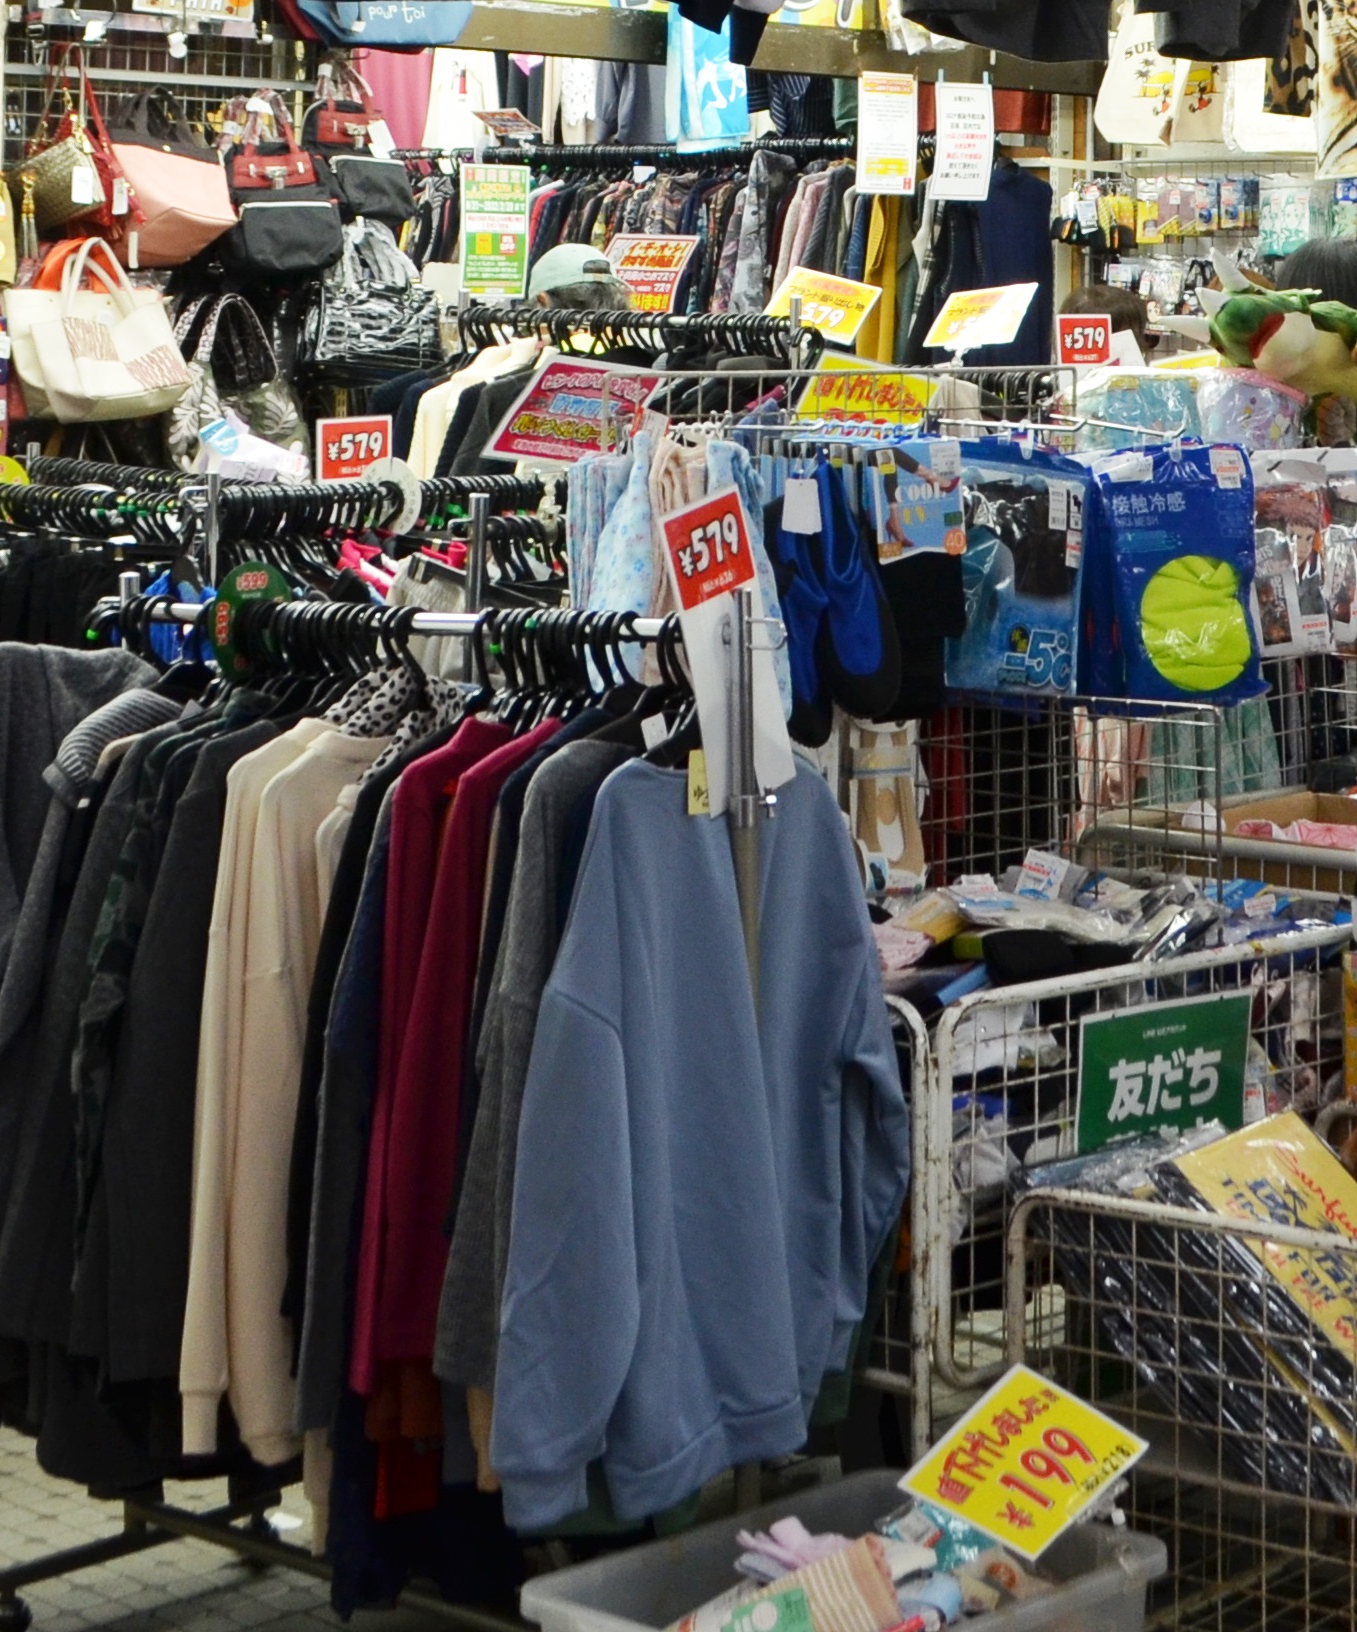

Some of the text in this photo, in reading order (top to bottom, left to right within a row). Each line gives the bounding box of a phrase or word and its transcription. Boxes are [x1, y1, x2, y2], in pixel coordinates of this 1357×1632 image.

[368, 0, 426, 24] pour toi
[1063, 326, 1106, 350] ¥579
[327, 431, 383, 461] ¥579
[1111, 490, 1187, 516] 接触冷感
[677, 512, 740, 577] ¥579
[1107, 1047, 1222, 1123] 友だち
[996, 1426, 1096, 1530] ¥199
